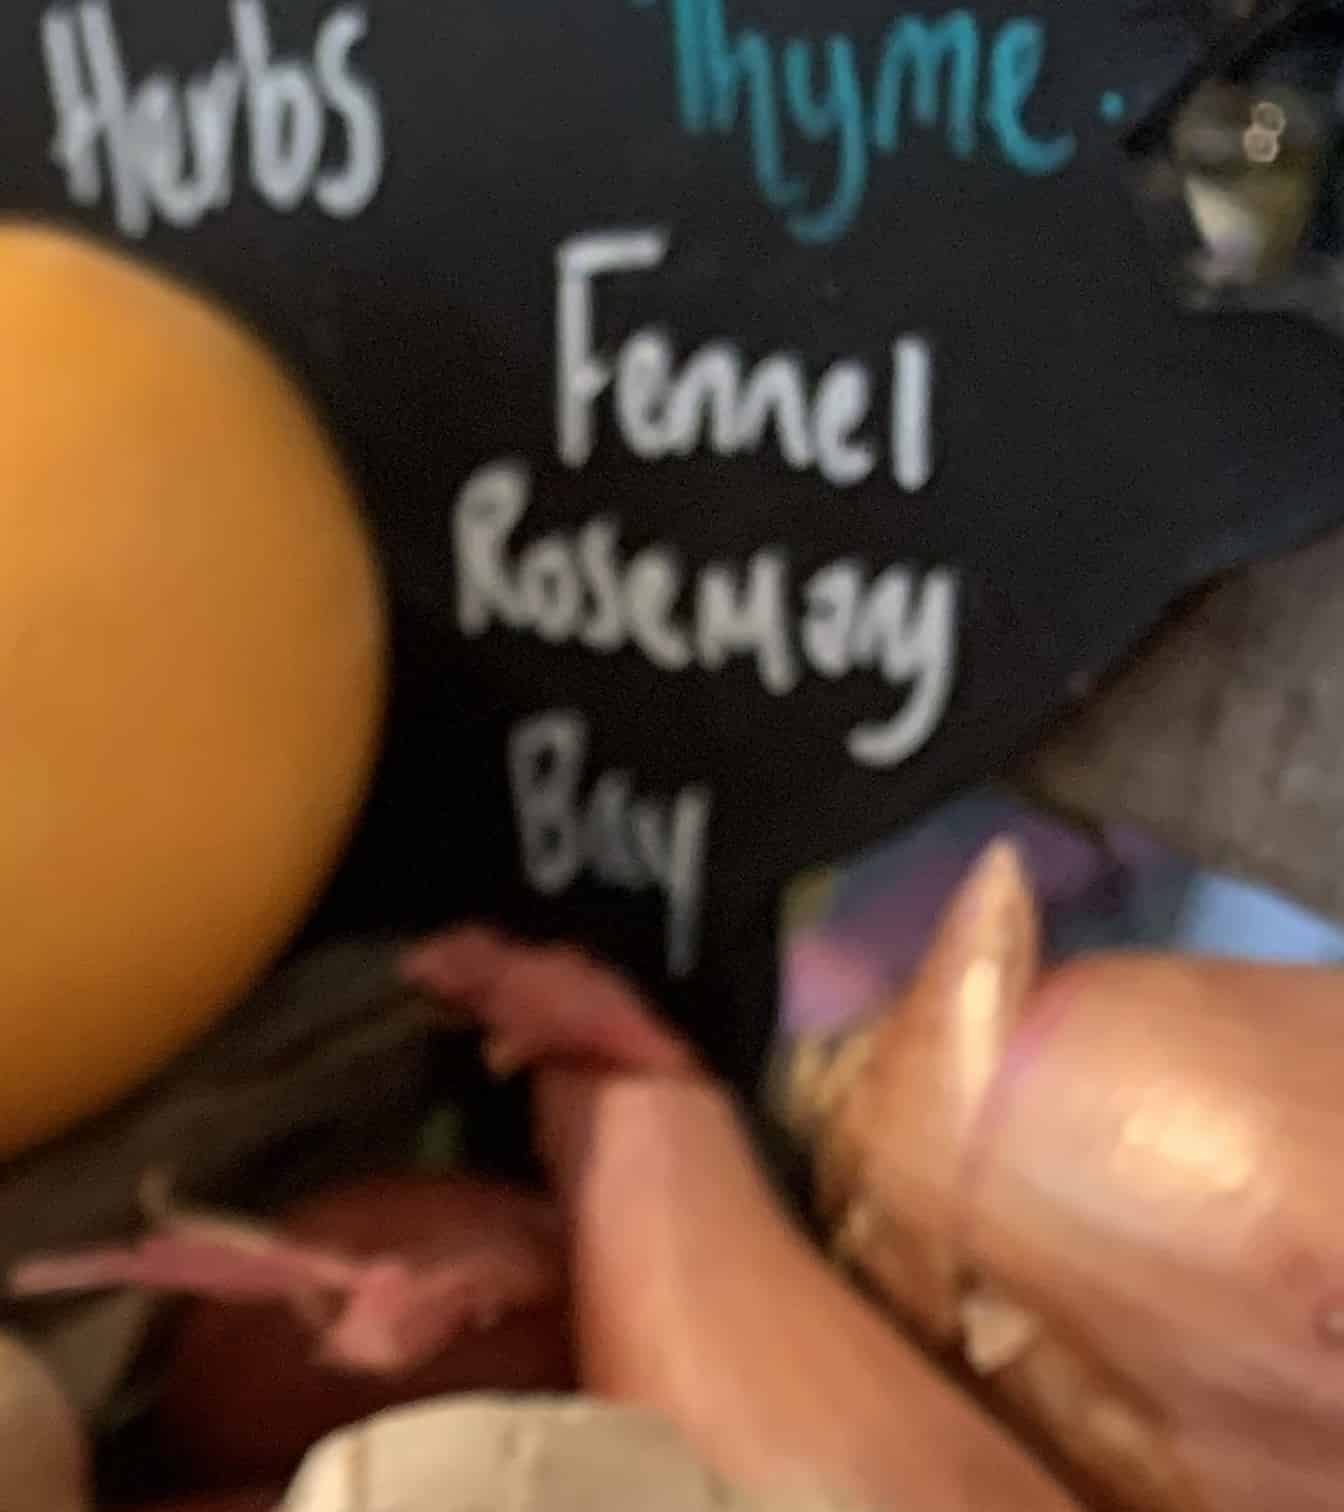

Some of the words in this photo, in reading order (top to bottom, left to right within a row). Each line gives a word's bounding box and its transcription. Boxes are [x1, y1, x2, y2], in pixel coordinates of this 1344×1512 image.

[42, 0, 383, 236] Herbs
[555, 228, 932, 492] Fennel
[510, 708, 709, 978] Bay
